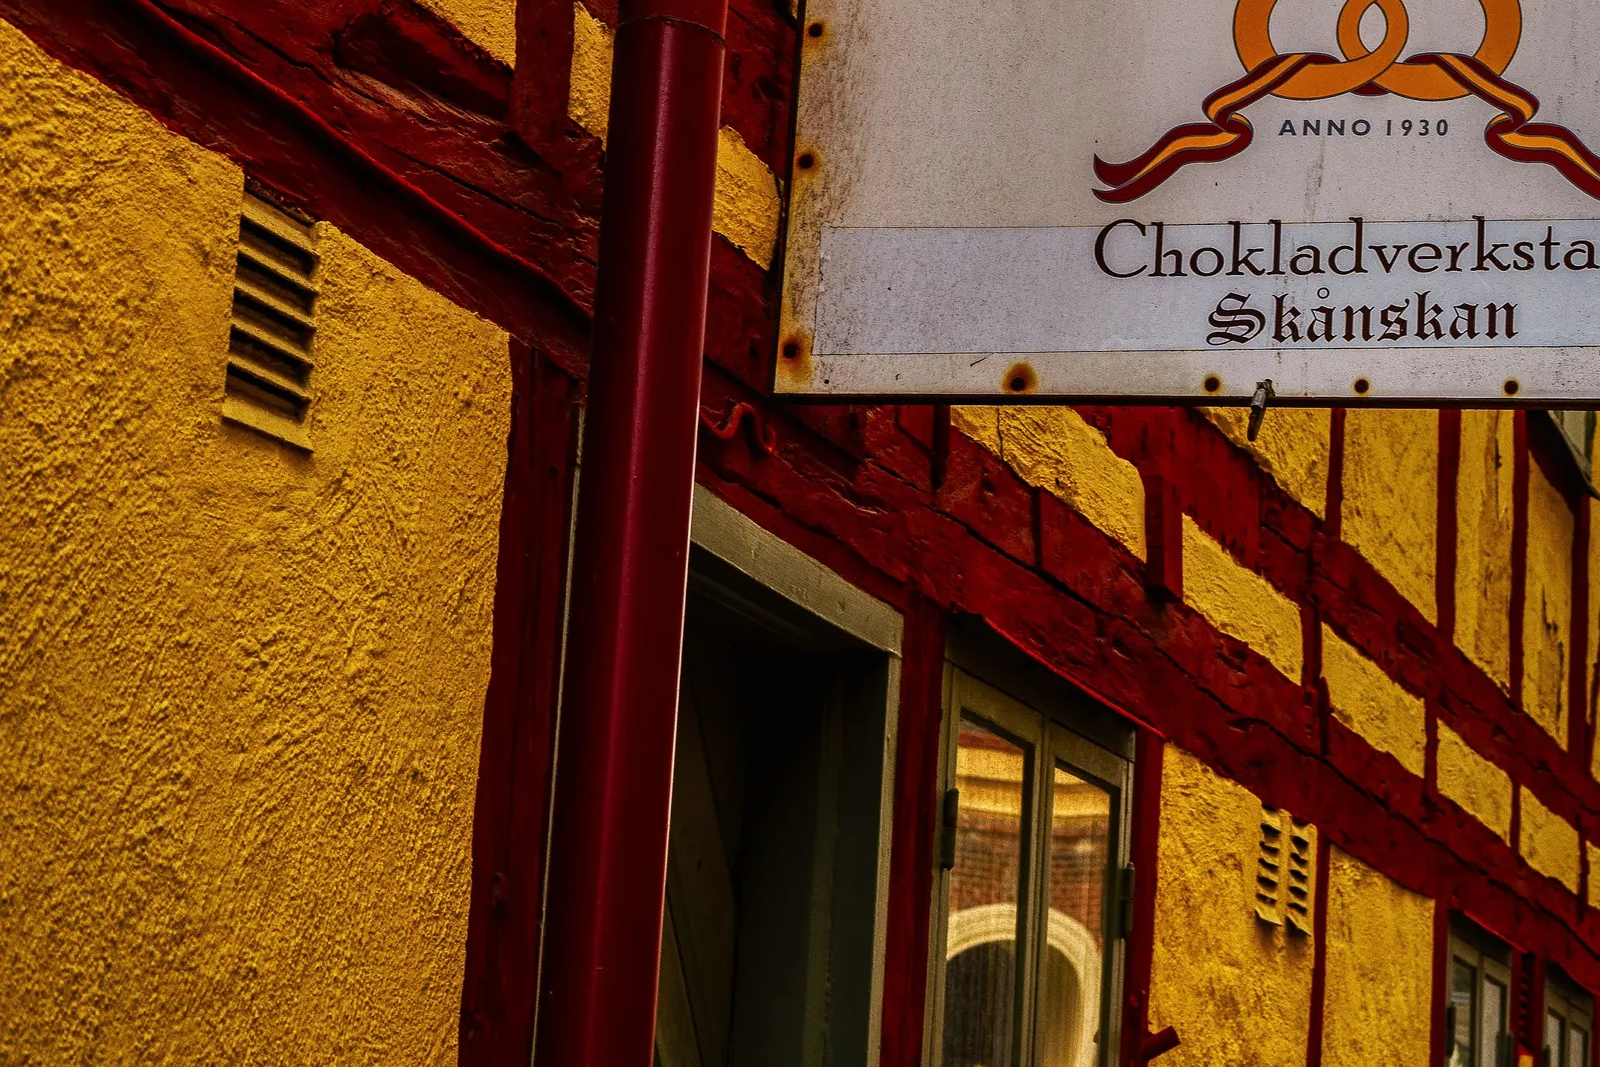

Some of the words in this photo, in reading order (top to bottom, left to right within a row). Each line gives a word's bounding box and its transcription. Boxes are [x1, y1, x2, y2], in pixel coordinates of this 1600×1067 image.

[1278, 118, 1372, 137] ANNO
[1386, 118, 1450, 137] 1930
[1205, 286, 1519, 346] Skånskan
